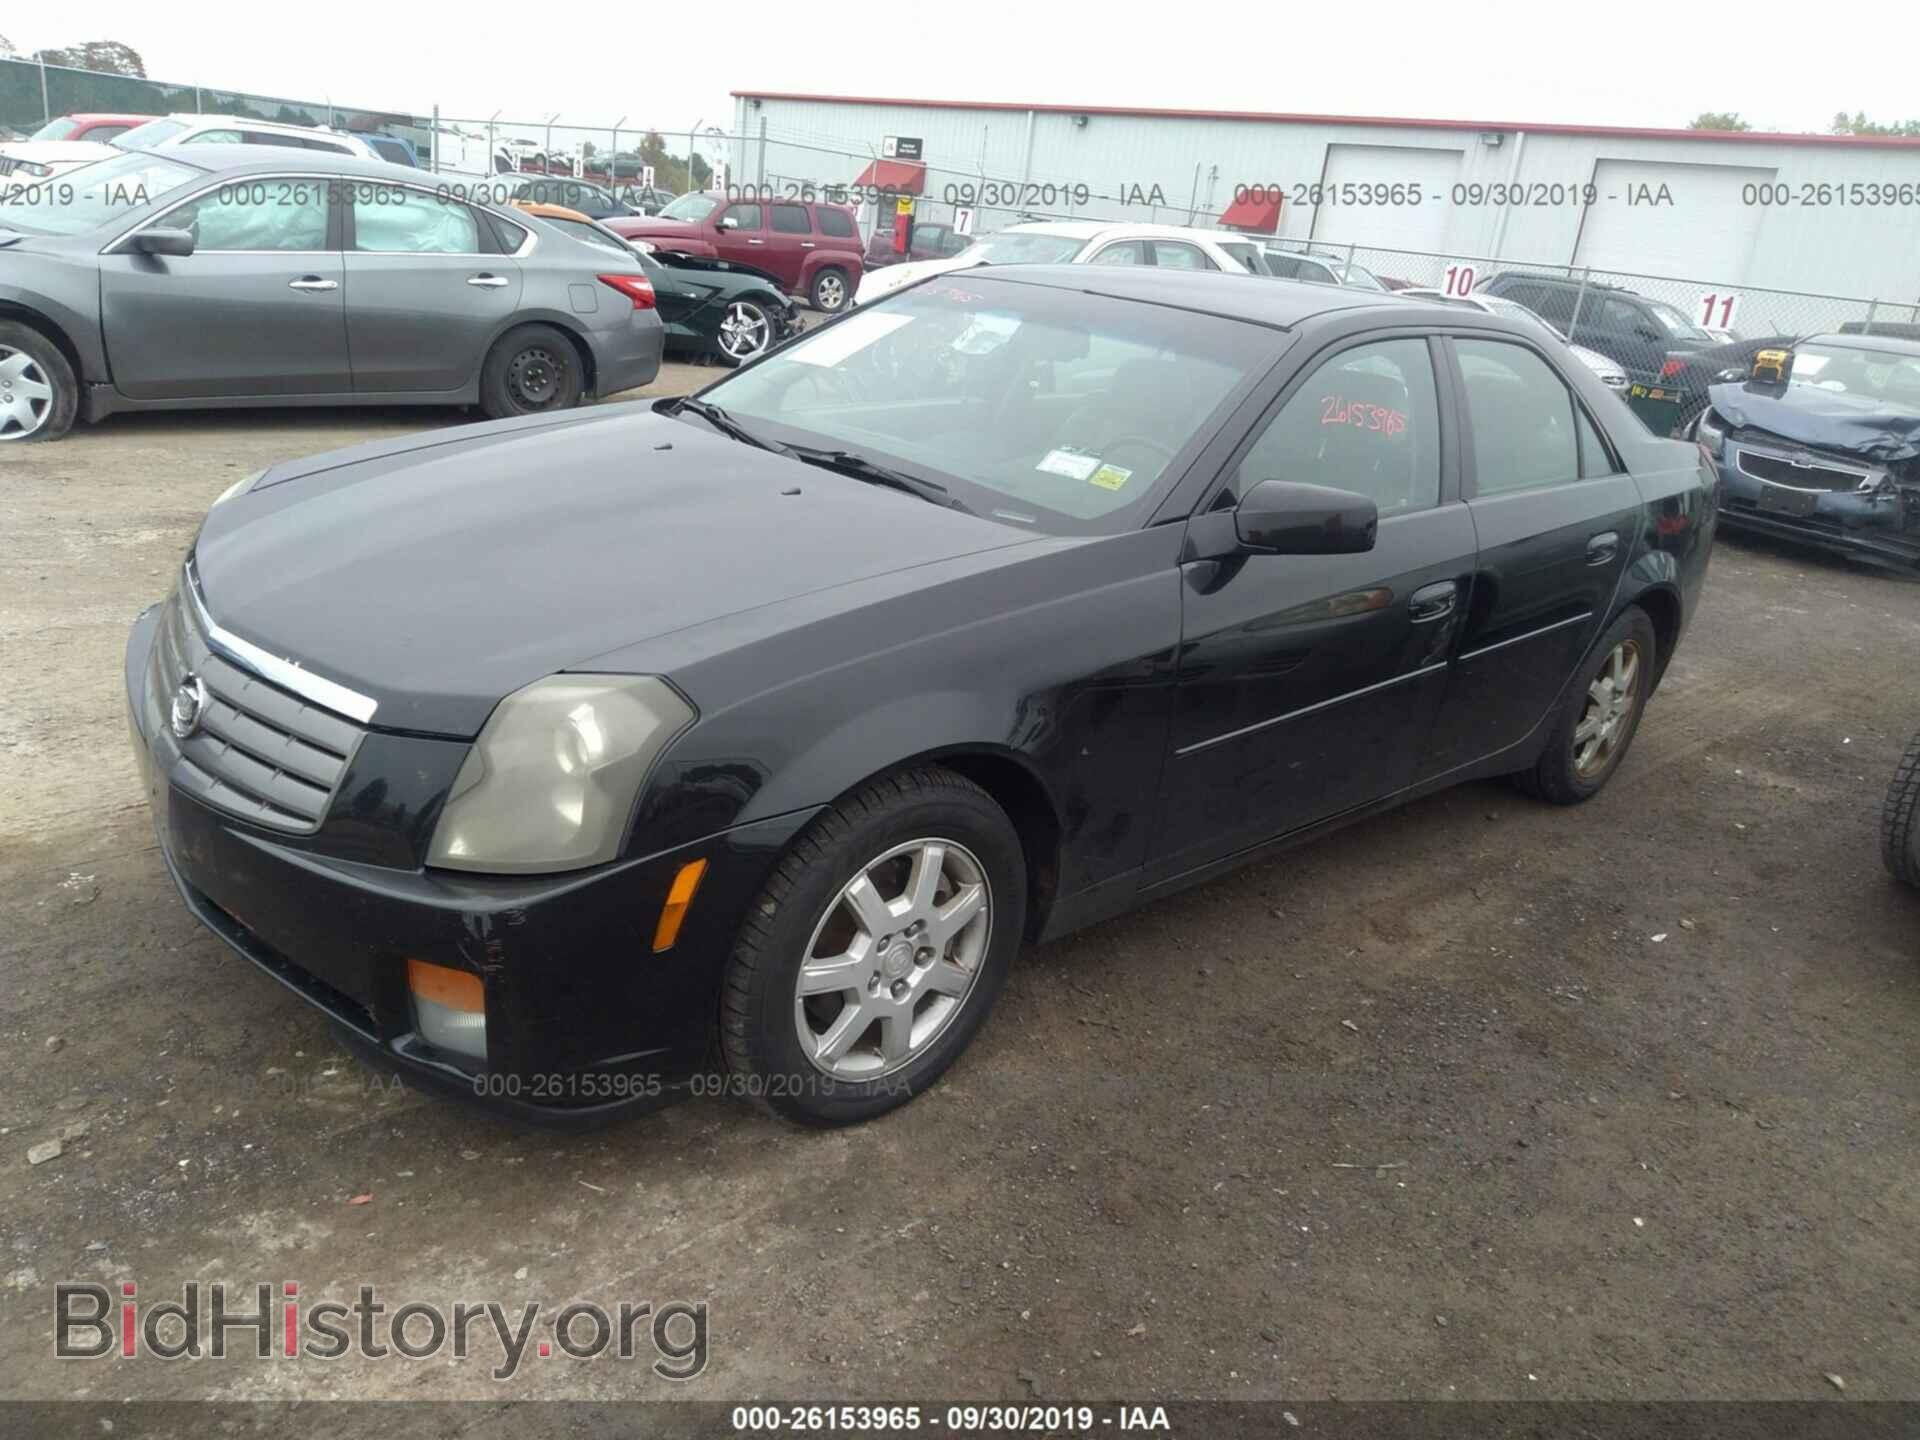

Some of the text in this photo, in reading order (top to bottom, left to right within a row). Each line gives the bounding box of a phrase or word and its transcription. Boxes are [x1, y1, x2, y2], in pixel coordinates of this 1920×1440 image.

[714, 174, 722, 191] 5
[959, 211, 969, 233] 7
[1445, 266, 1474, 297] 10
[1702, 294, 1734, 328] 11
